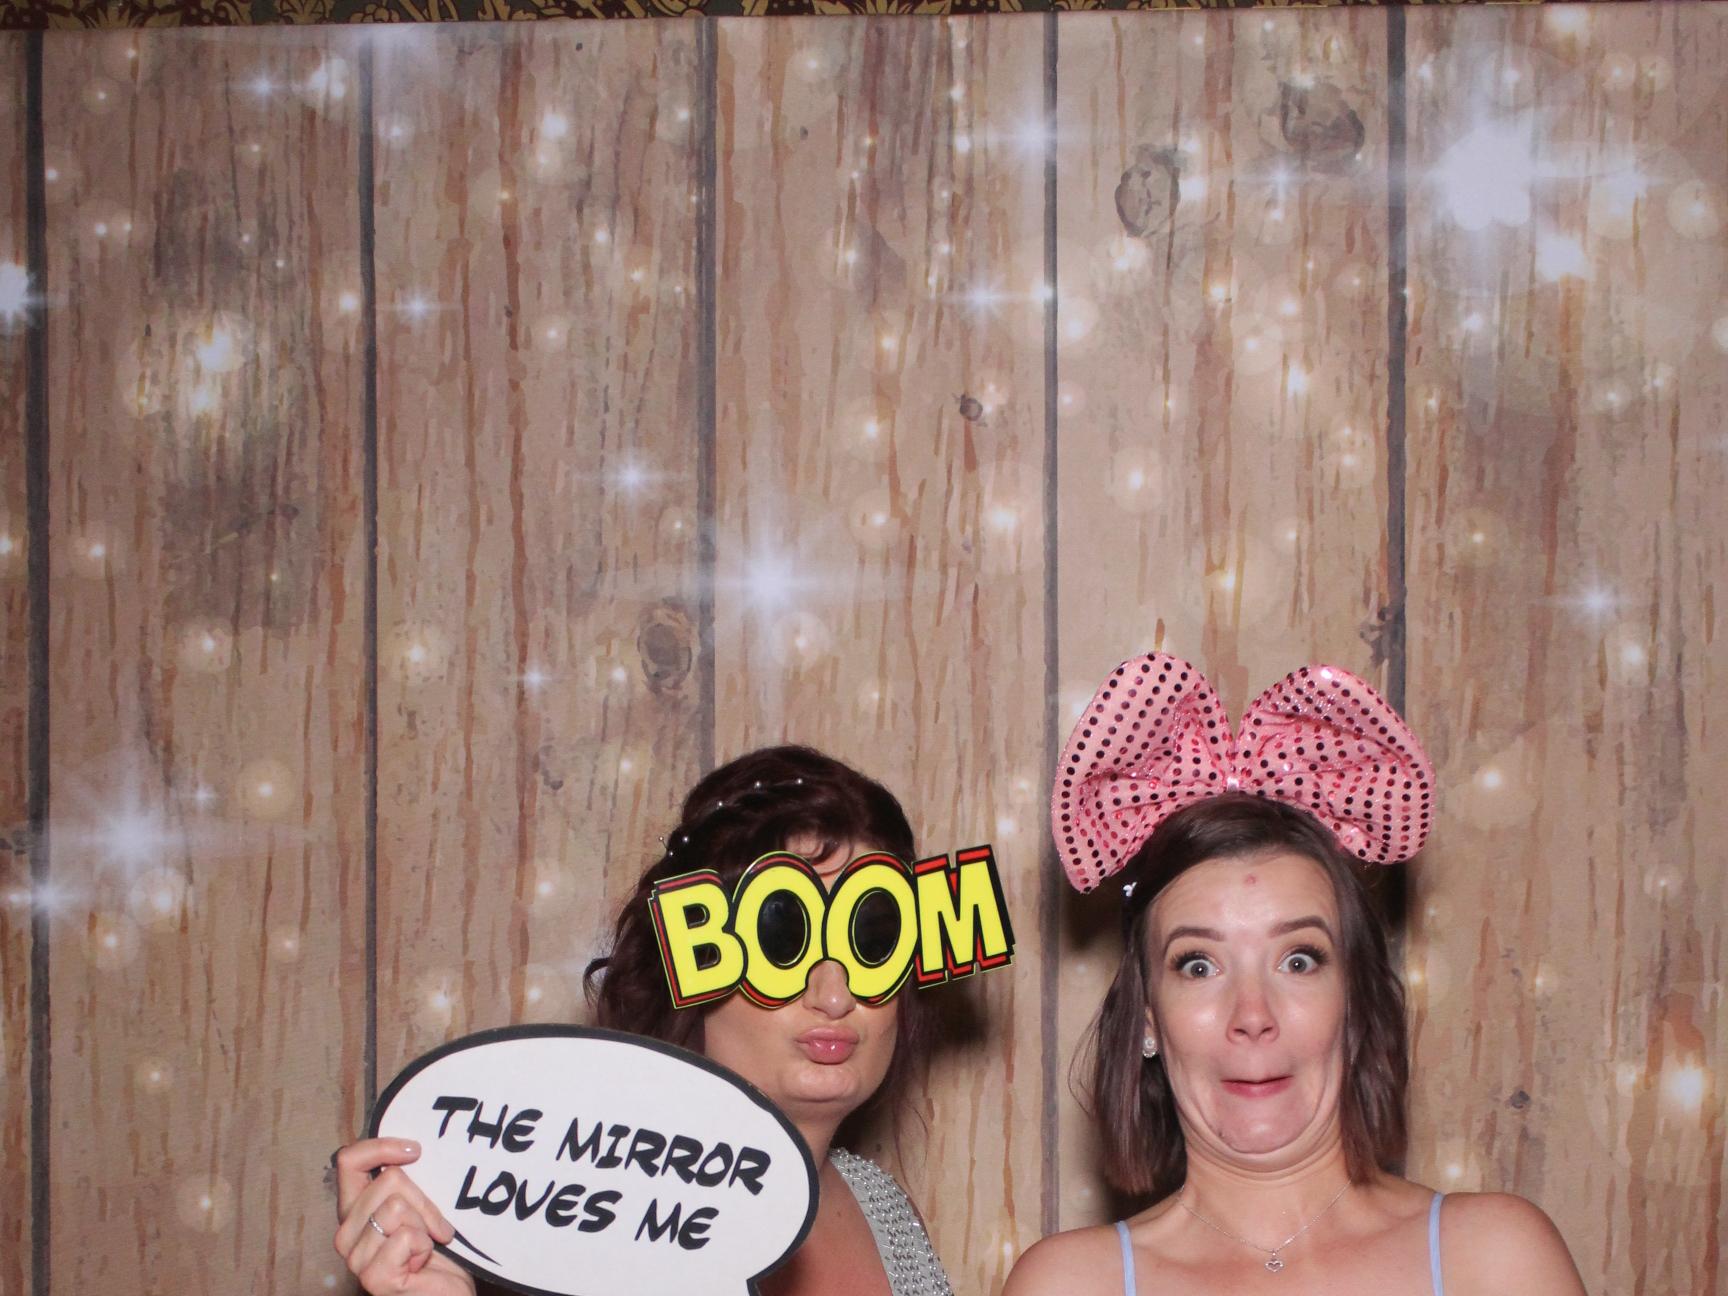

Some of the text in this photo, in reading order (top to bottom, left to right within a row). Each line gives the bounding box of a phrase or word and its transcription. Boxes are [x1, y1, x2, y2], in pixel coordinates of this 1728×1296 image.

[652, 849, 1013, 1006] BOOM
[432, 1096, 771, 1196] THE MIRROR
[455, 1165, 720, 1250] LOVES ME
